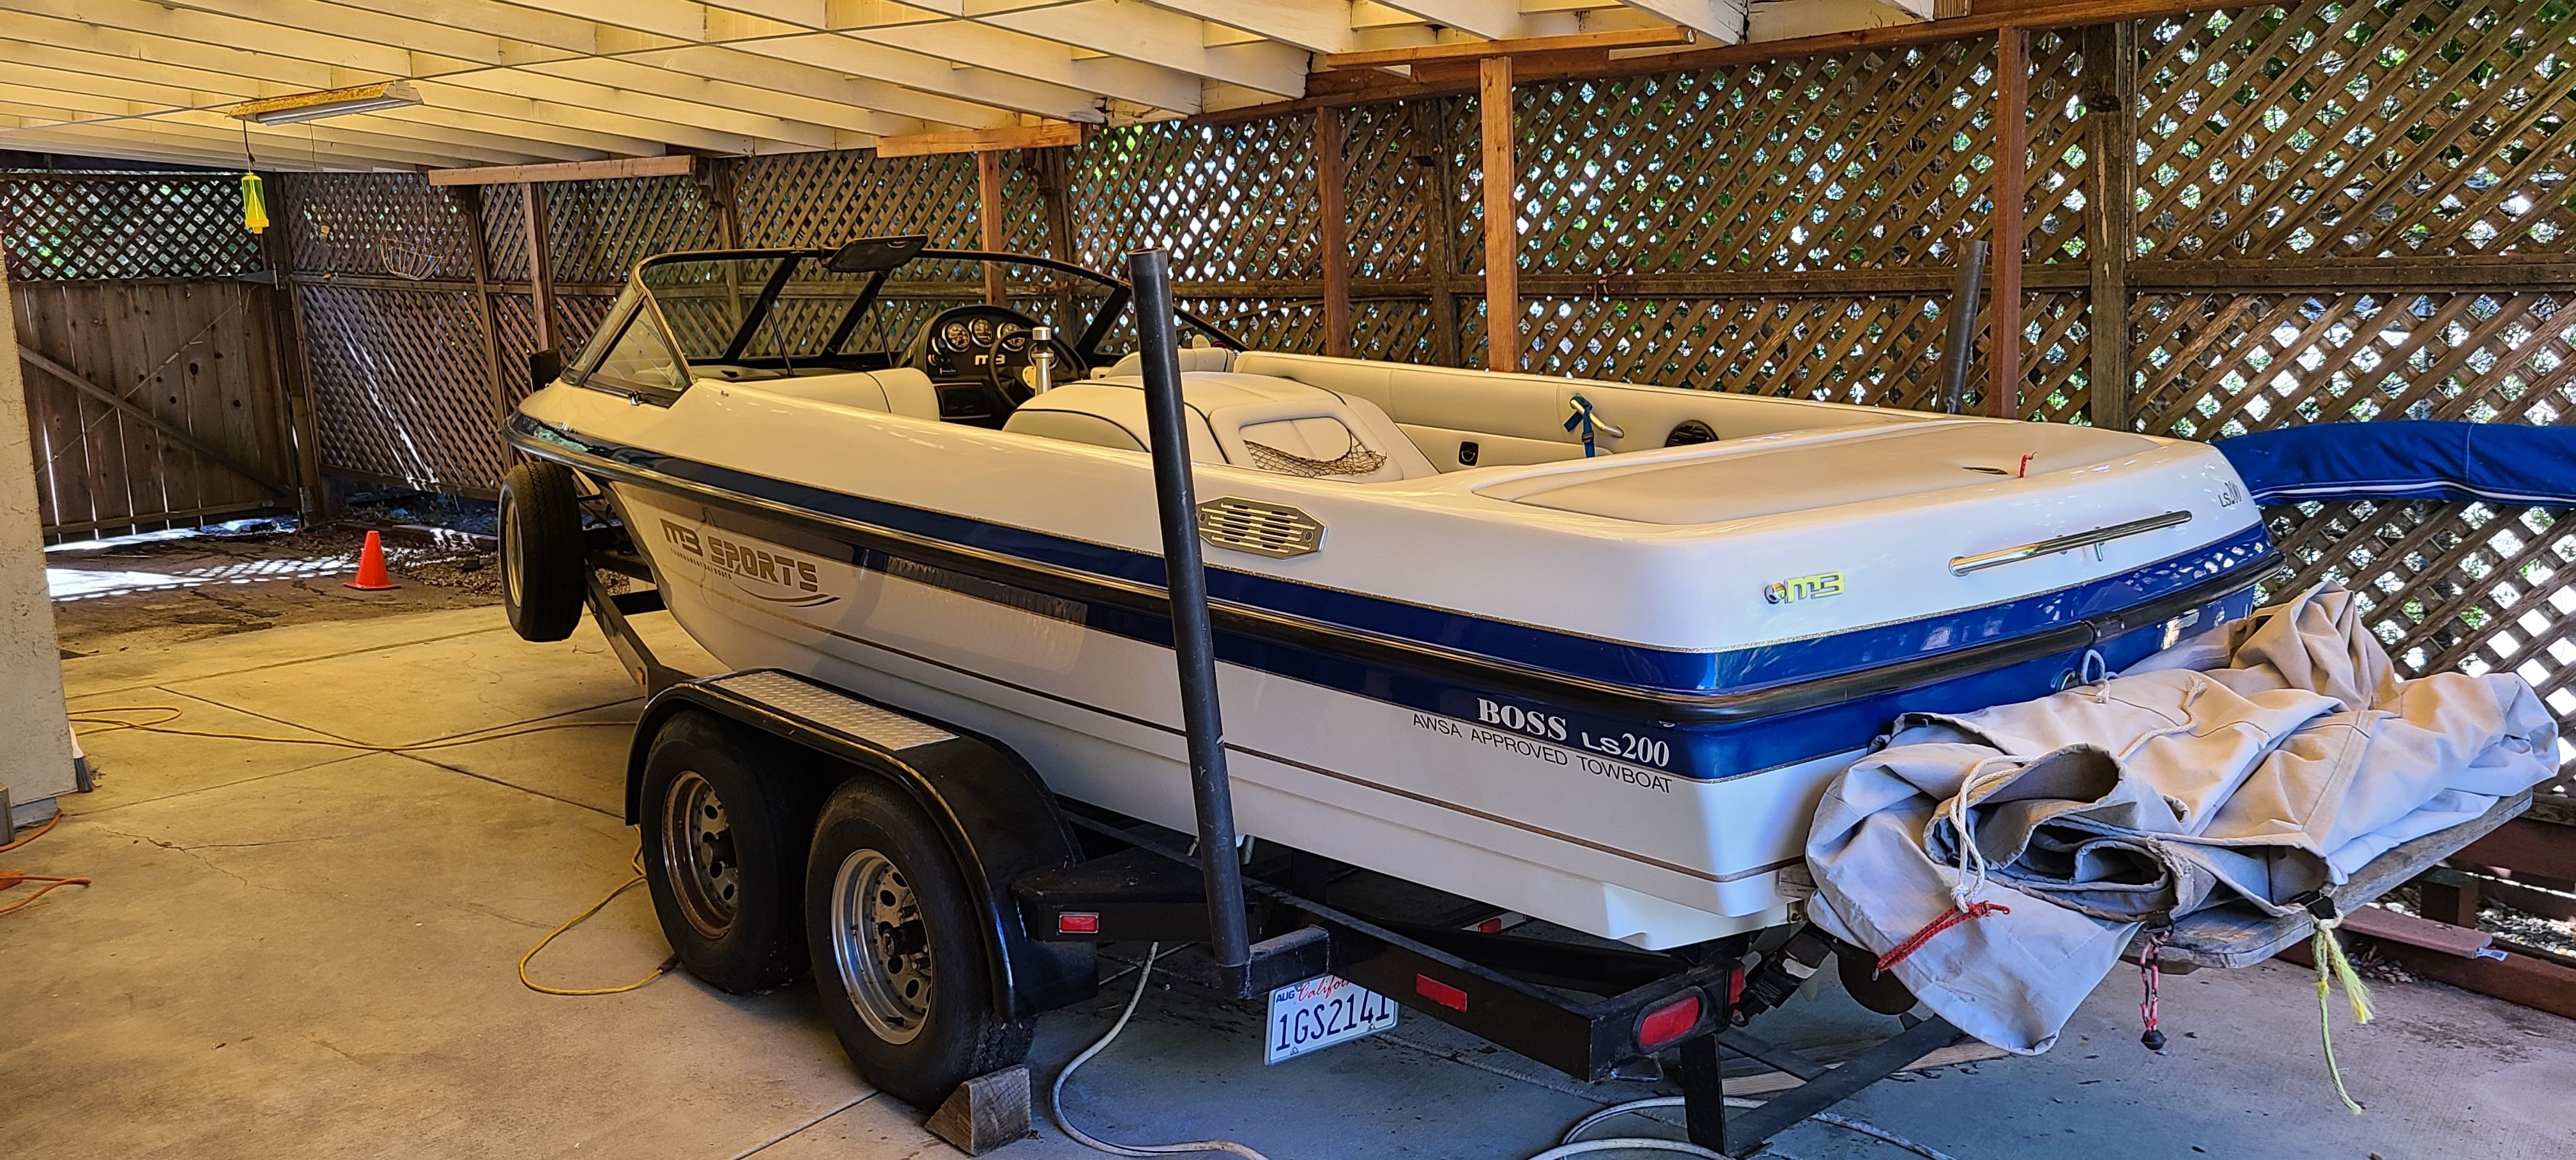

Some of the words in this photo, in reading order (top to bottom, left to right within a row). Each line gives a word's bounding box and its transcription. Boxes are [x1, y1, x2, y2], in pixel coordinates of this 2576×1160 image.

[707, 535, 818, 593] SPORTS
[1413, 713, 1462, 738] AWSA
[1471, 728, 1568, 766] APPROVED
[1575, 754, 1673, 794] TOWBOAT
[1477, 698, 1567, 740] BOSS
[1581, 732, 1670, 767] LS200
[1276, 990, 1295, 1003] AUG
[1276, 989, 1390, 1051] 1GS2141
